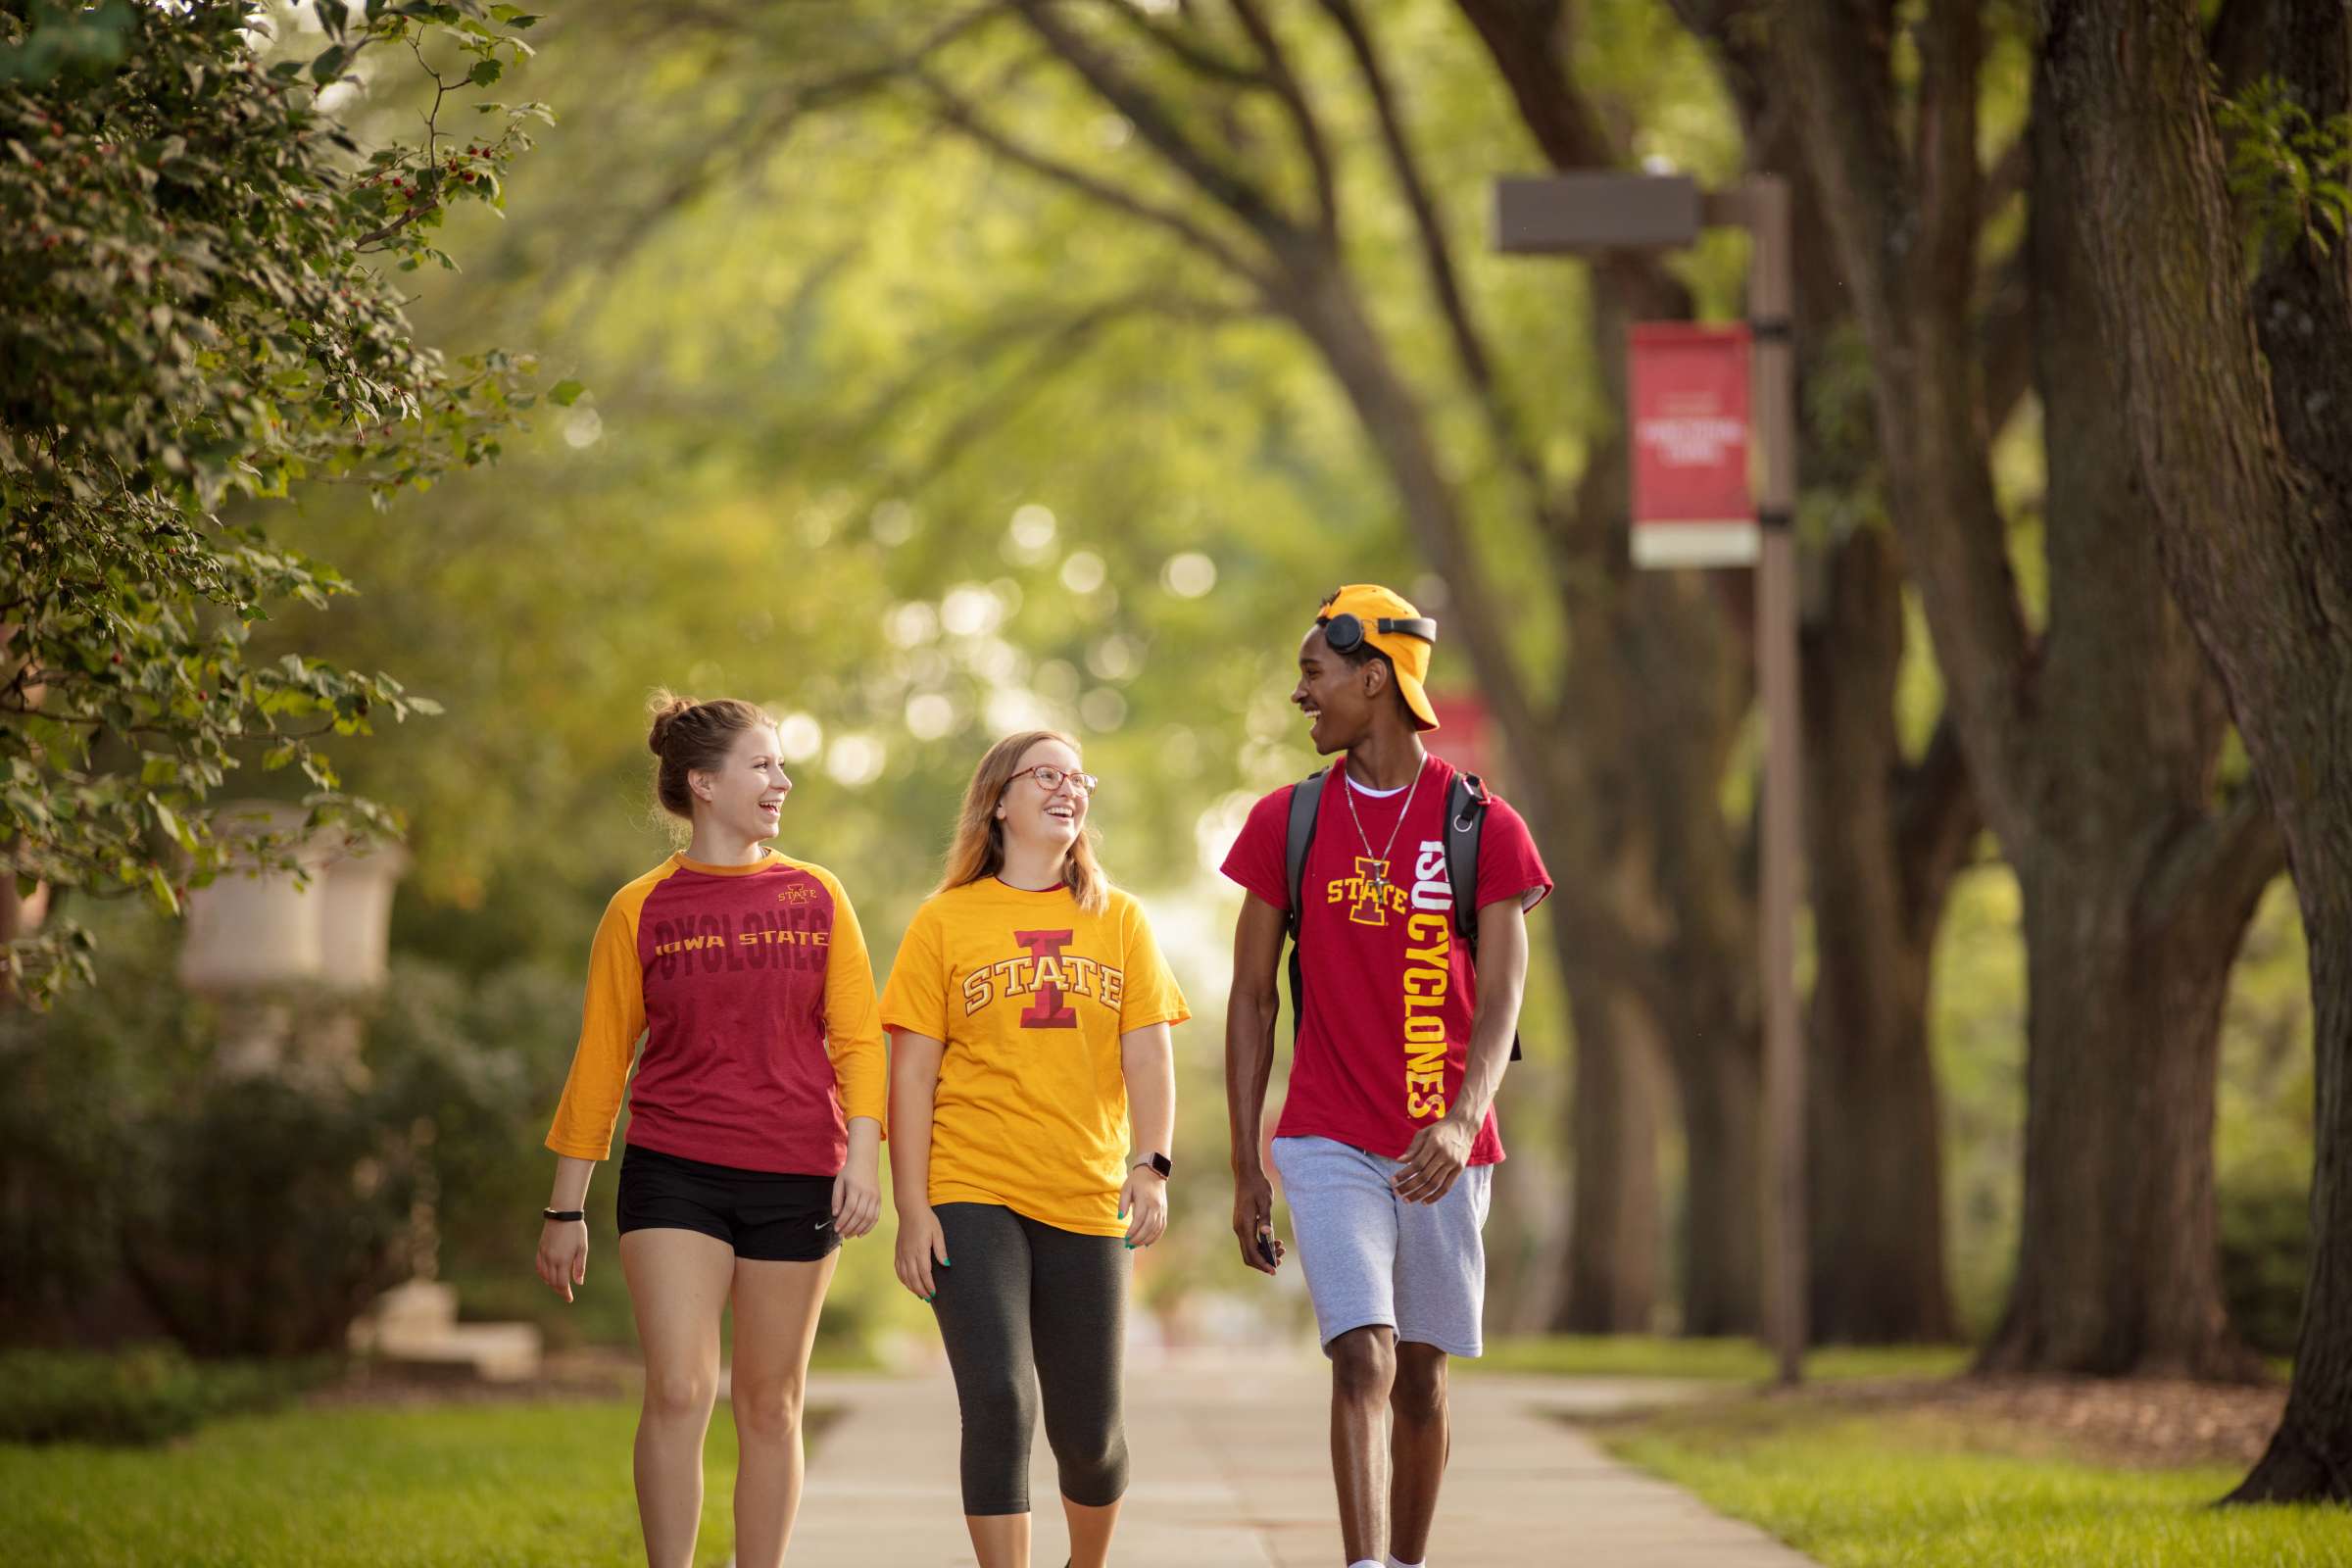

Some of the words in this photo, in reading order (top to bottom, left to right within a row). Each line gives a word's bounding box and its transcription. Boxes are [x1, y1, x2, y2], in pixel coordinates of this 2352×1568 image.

[778, 889, 818, 902] STATE
[1327, 877, 1409, 915] STATE
[1411, 840, 1454, 911] ISU
[655, 935, 726, 956] IOWA
[739, 930, 830, 947] STATE
[655, 907, 830, 981] CYCLONES
[962, 955, 1125, 1018] STATE
[1402, 912, 1450, 1119] CYCLONES
